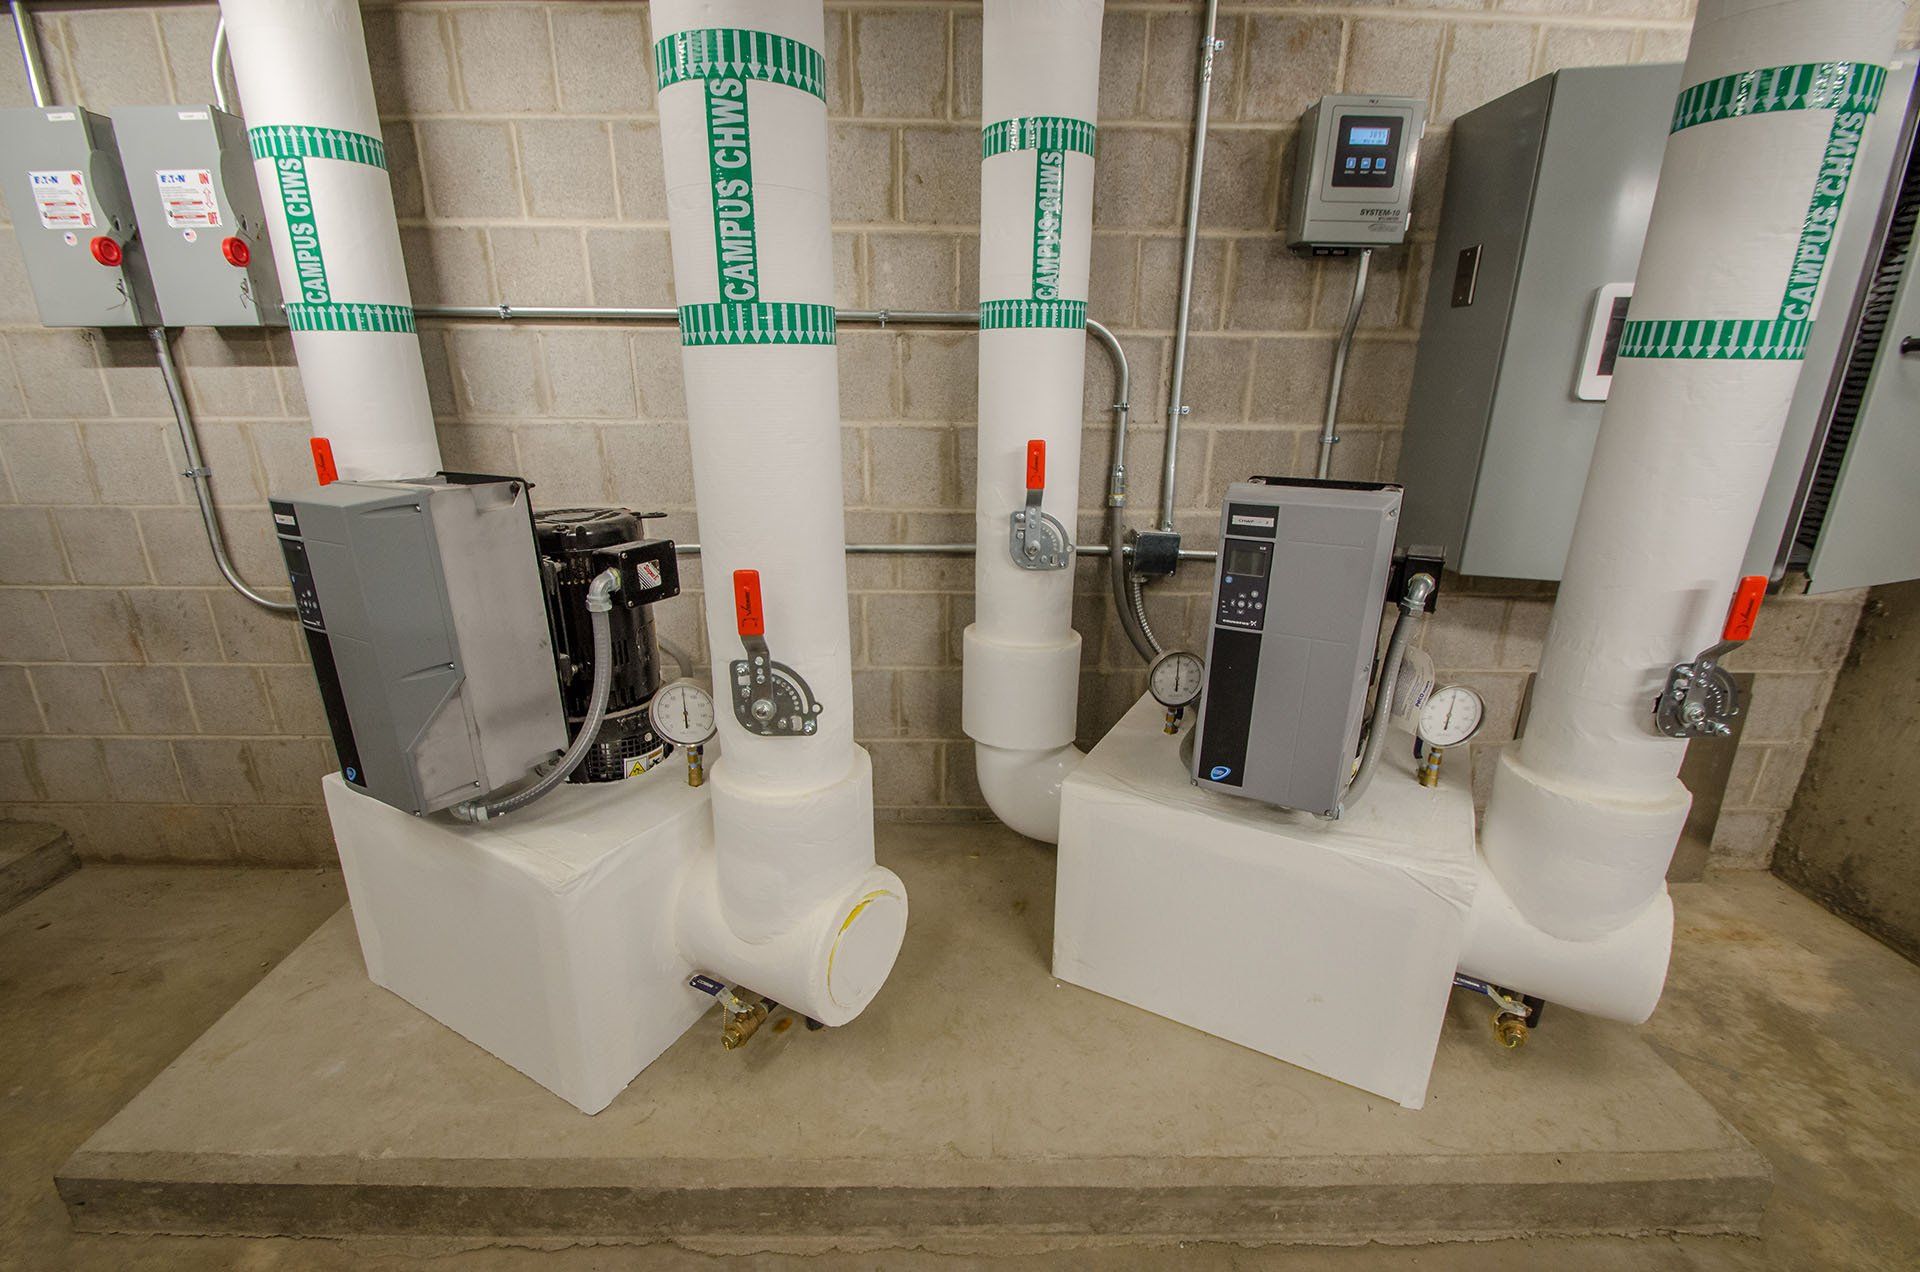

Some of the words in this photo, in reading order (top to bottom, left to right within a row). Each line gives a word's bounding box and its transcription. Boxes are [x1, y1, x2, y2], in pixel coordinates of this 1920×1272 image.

[709, 78, 749, 169] CHWS
[278, 156, 311, 217] CHWS
[1039, 151, 1063, 211] CHWS
[1359, 208, 1401, 217] SYSTEM-10
[1783, 206, 1837, 321] CAMPUS
[1822, 111, 1865, 198] CHWS
[291, 223, 328, 304] CAMPUS
[716, 179, 756, 302] CAMPUS
[1035, 218, 1060, 300] CAMPUS
